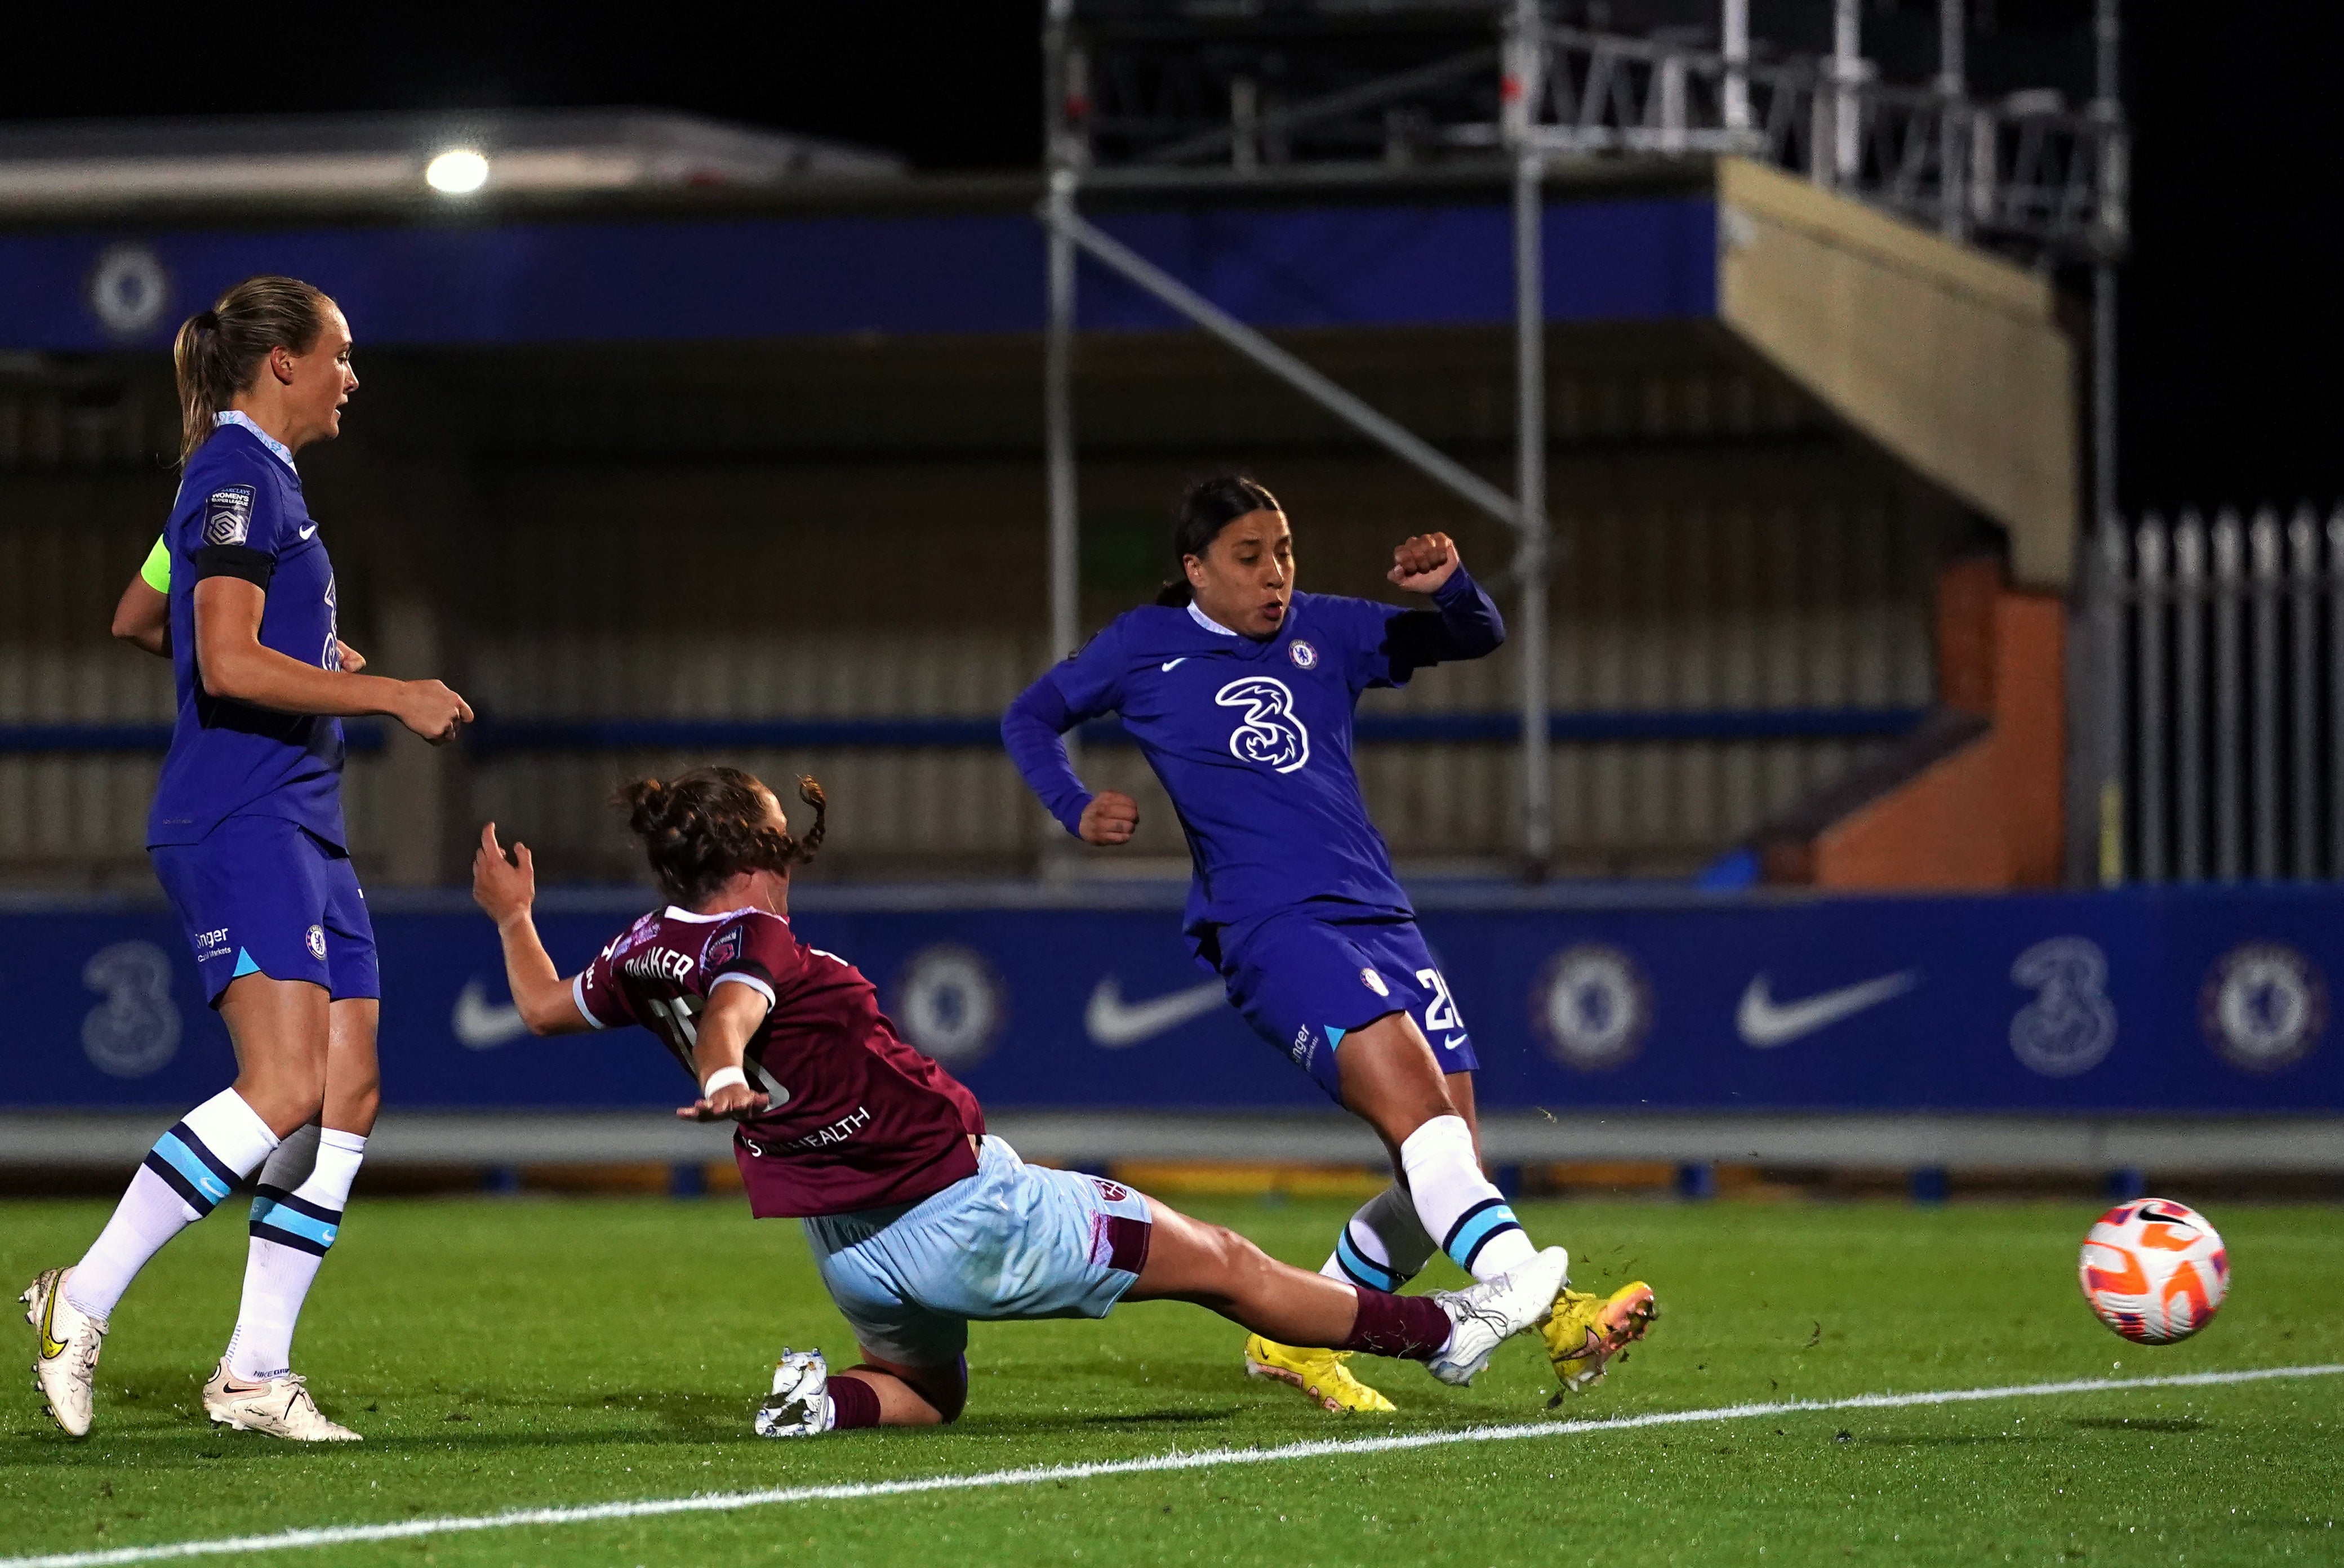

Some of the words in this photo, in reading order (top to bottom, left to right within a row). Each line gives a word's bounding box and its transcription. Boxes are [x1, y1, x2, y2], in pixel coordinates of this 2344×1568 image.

[212, 492, 250, 502] WOMEN'S
[1215, 676, 1309, 773] 3
[195, 928, 228, 948] inger
[2009, 935, 2118, 1077] 3
[1292, 1023, 1309, 1063] nger
